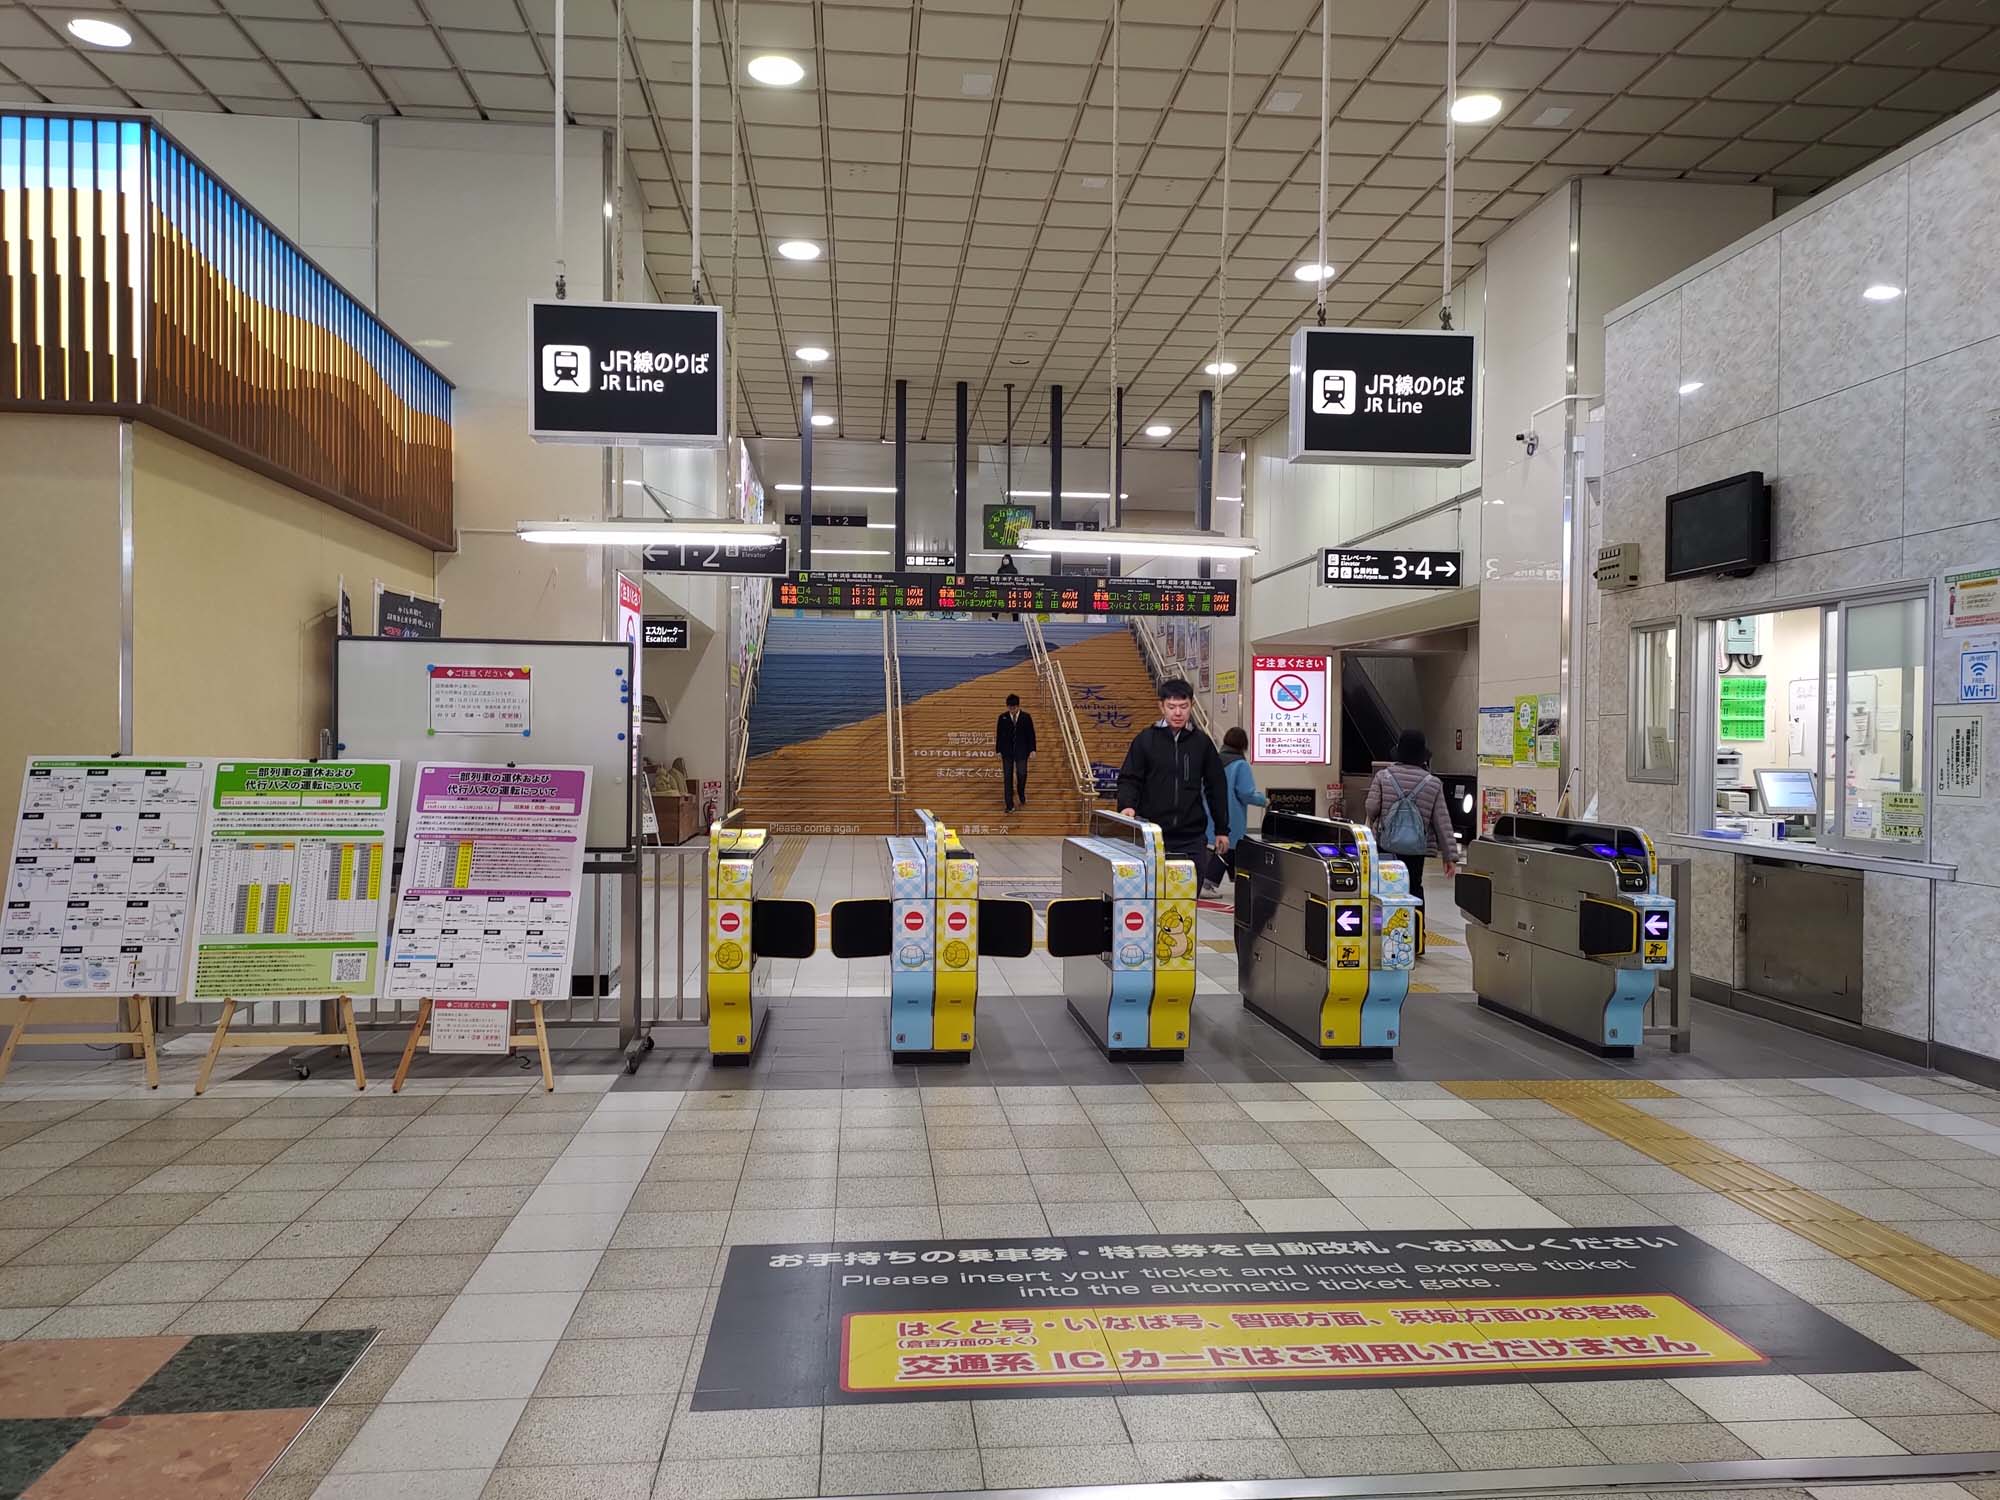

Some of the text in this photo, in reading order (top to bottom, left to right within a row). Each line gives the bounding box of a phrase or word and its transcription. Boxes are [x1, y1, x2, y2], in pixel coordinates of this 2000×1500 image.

[600, 350, 709, 374] JR線のりば
[600, 374, 664, 392] JR Line
[1365, 374, 1465, 397] JR線のりば
[1364, 397, 1423, 414] JR Line
[939, 588, 955, 598] 普通
[1008, 591, 1032, 599] 14:50
[851, 597, 875, 606] 16:21
[1008, 600, 1032, 608] 15:14
[1161, 603, 1184, 612] 15:12
[645, 626, 684, 636] エスカレーター
[1256, 658, 1324, 668] ご注意ください
[455, 670, 508, 678] ご注意ください
[1964, 684, 1994, 696] Wi-Fi
[1270, 712, 1308, 720] ICカード
[246, 766, 354, 778] 一部列車の運休および
[449, 772, 550, 784] 一部列車の運休および
[936, 768, 1004, 778] また来てくださ
[245, 780, 362, 790] 代行バスの運転について
[447, 784, 557, 796] 代行バスの運転について
[769, 823, 802, 833] Please
[834, 824, 860, 834] again
[769, 1236, 1679, 1268] お手持ちの乗車券・特急券を自動改札へお通しください
[841, 1259, 1637, 1287] Please insert your ticket and limited express ticket
[1019, 1277, 1501, 1298] into the automatic ticket gate.
[902, 1334, 1699, 1375] 交通系 IC カードはご利用いただけません
